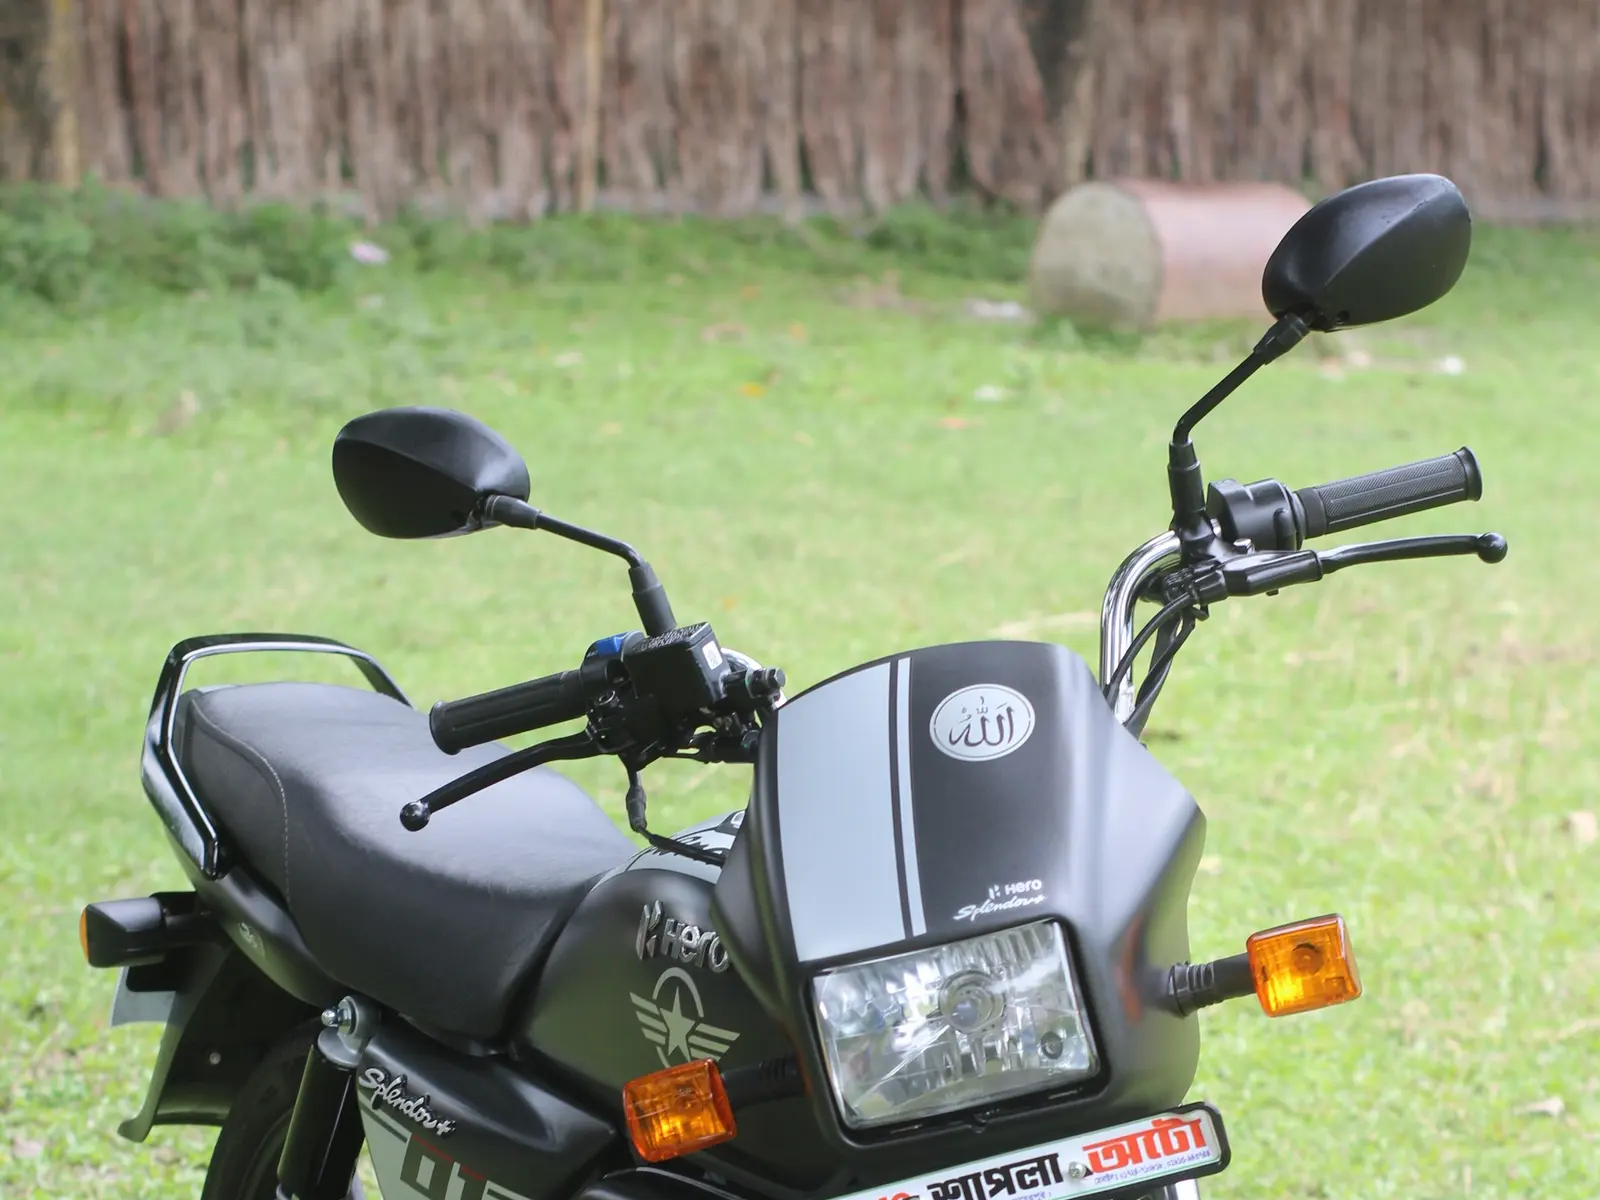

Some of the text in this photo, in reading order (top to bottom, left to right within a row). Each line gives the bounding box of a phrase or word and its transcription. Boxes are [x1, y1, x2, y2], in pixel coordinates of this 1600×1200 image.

[1005, 879, 1042, 895] Hero
[661, 918, 731, 973] Hero
[1082, 1117, 1206, 1173] অটো
